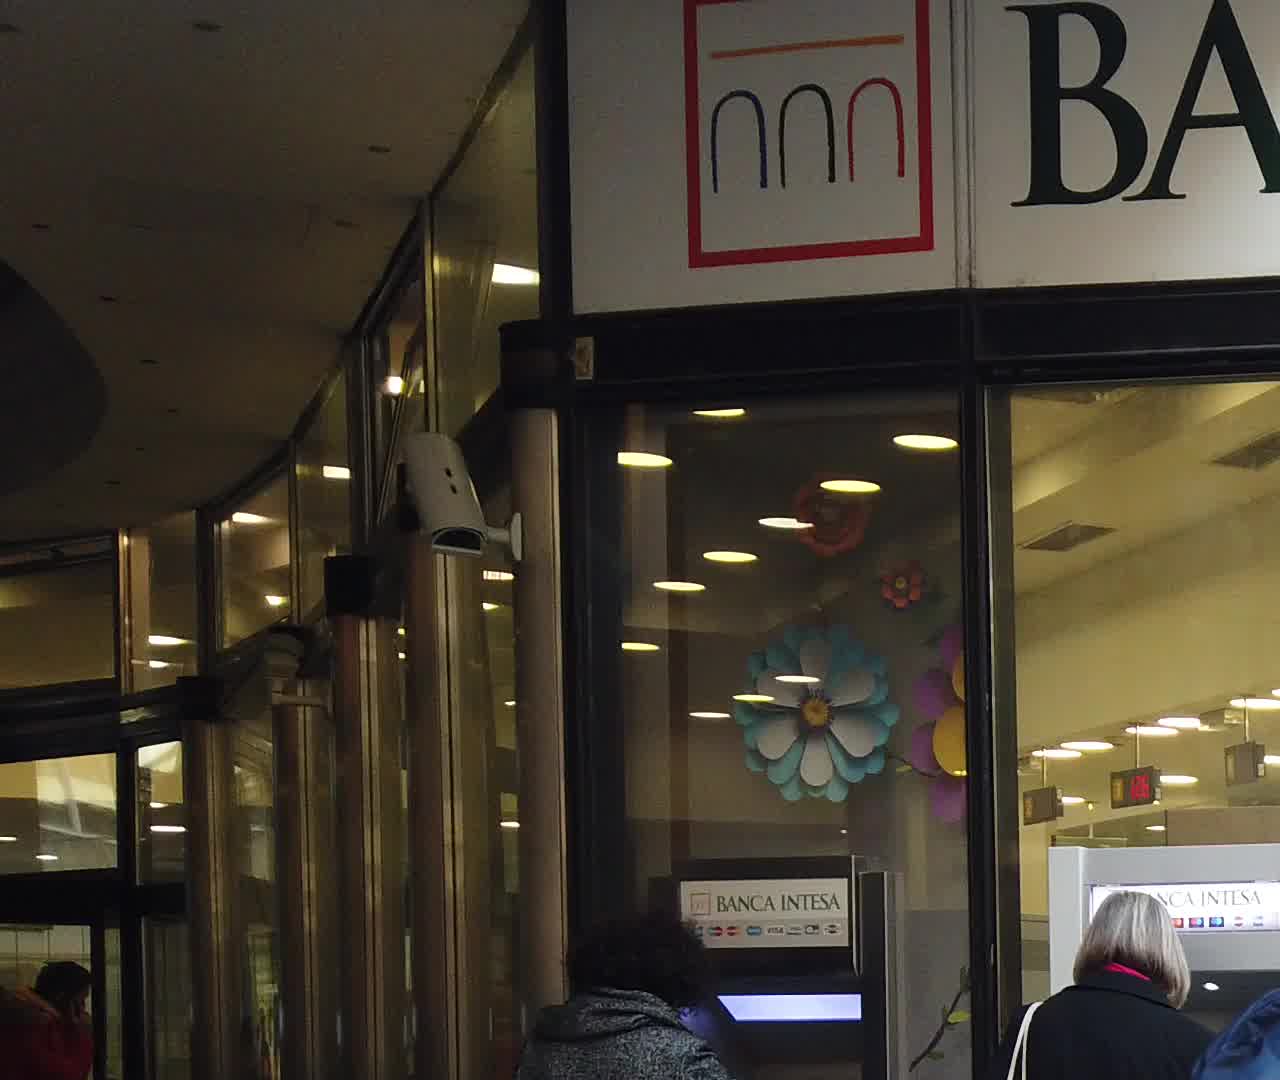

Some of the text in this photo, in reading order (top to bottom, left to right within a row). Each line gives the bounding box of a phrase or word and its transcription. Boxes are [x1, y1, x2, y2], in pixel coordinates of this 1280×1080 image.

[716, 893, 841, 912] BANCA INTESA
[1201, 889, 1261, 906] INTESA
